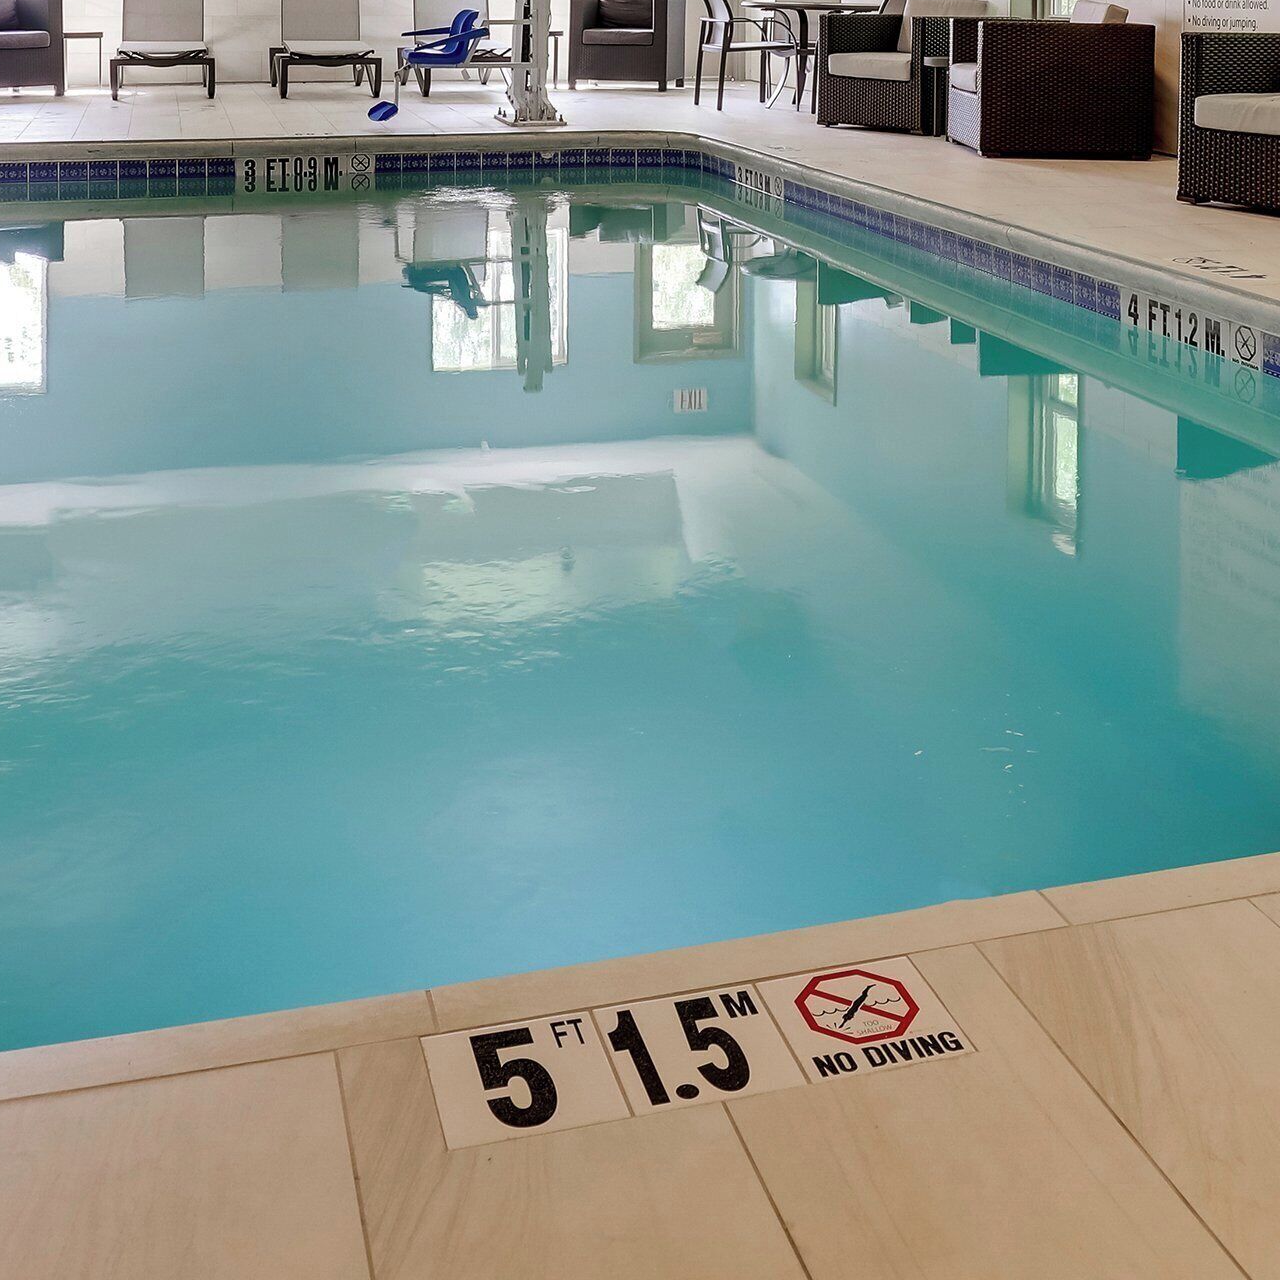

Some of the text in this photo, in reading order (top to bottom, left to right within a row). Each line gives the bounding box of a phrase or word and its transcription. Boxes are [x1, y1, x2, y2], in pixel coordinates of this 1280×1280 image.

[1217, 0, 1224, 9] or
[1192, 15, 1258, 31] No diving or jumping.
[1128, 294, 1225, 357] 4 FT. 1.2 M.
[856, 1024, 893, 1036] SHALLOW
[469, 990, 759, 1128] 5 FT 1.5 M
[812, 1031, 964, 1078] NO DIVING
